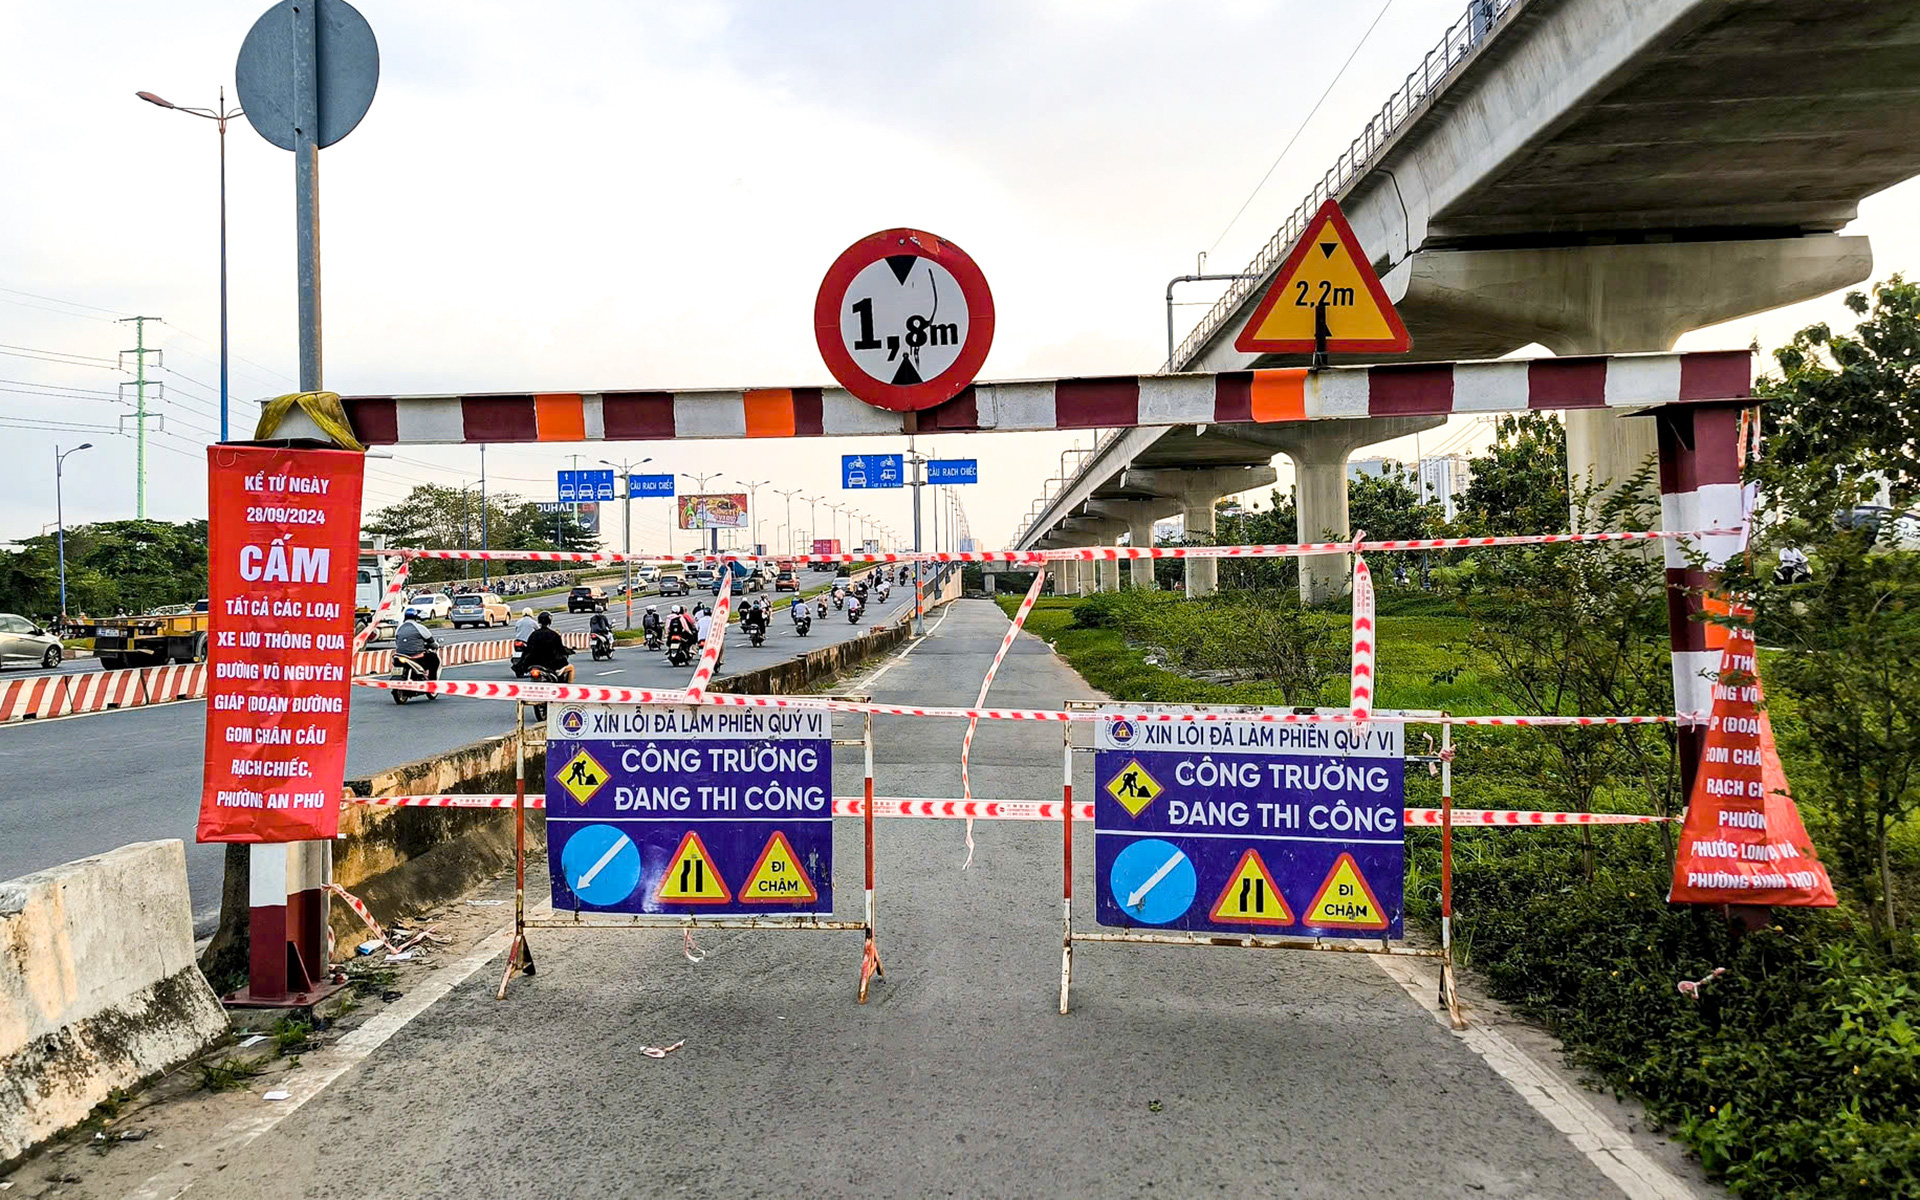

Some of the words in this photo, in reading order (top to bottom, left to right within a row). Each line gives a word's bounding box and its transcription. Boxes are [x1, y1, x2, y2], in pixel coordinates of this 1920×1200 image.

[1295, 280, 1354, 310] 2,2m
[851, 298, 959, 361] 1,8m
[929, 467, 940, 476] CẦU
[943, 467, 958, 478] RẠCH
[960, 463, 976, 475] CHIẾC
[245, 471, 264, 490] KỂ
[268, 474, 286, 491] TỪ
[289, 476, 329, 493] NGÀY
[630, 480, 640, 490] CẦU
[643, 482, 656, 491] RẠCH
[658, 479, 673, 490] CHIẾC
[247, 507, 325, 524] 28/09/2024
[537, 504, 573, 512] DUHAL
[240, 534, 329, 583] CẤM
[226, 598, 248, 615] TẤT
[252, 596, 268, 615] CẢ
[274, 599, 301, 616] CÁC
[306, 603, 339, 620] LOẠI
[218, 632, 235, 646] XE
[240, 631, 260, 647] LƯU
[265, 631, 311, 648] THÔNG
[317, 634, 344, 650] QUA
[217, 660, 258, 678] ĐƯỜNG
[264, 663, 279, 679] VÕ
[284, 663, 343, 680] NGUYÊN
[215, 692, 244, 709] GIÁP
[292, 694, 342, 712] ĐƯỜNG
[594, 712, 618, 732] XIN
[625, 706, 648, 732] LỖI
[655, 710, 676, 732] ĐÃ
[719, 707, 763, 732] PHIỀN
[769, 709, 802, 737] QUÝ
[807, 714, 821, 737] VỊ
[226, 727, 252, 742] GOM
[256, 726, 291, 744] CHÂN
[296, 724, 326, 744] CẦU
[1145, 725, 1172, 745] XIN
[1210, 722, 1237, 746] ĐÃ
[1239, 725, 1273, 747] LÀM
[1280, 723, 1329, 749] PHIỀN
[1377, 732, 1394, 757] VỊ
[622, 742, 701, 772] CÔNG
[708, 742, 818, 772] TRƯỜNG
[231, 760, 262, 778] RẠCH
[264, 757, 312, 778] CHIẾC,
[1175, 755, 1261, 788] CÔNG
[1268, 760, 1390, 793] TRƯỜNG
[614, 786, 690, 810] ĐANG
[698, 786, 737, 810] THI
[744, 780, 824, 810] CÔNG
[1707, 779, 1743, 797] RẠCH
[217, 789, 263, 808] PHƯỜNG
[267, 794, 289, 808] AN
[294, 790, 324, 808] PHÚ
[1168, 802, 1249, 828] ĐANG
[1257, 804, 1299, 828] THI
[1308, 799, 1397, 832] CÔNG
[1691, 839, 1738, 858] PHƯỚC
[1778, 840, 1799, 858] VÀ
[772, 861, 784, 873] ĐI
[758, 878, 798, 895] CHẬM
[1688, 871, 1750, 888] PHƯỜNG
[1339, 884, 1353, 896] ĐI
[1324, 901, 1368, 918] CHẬM
